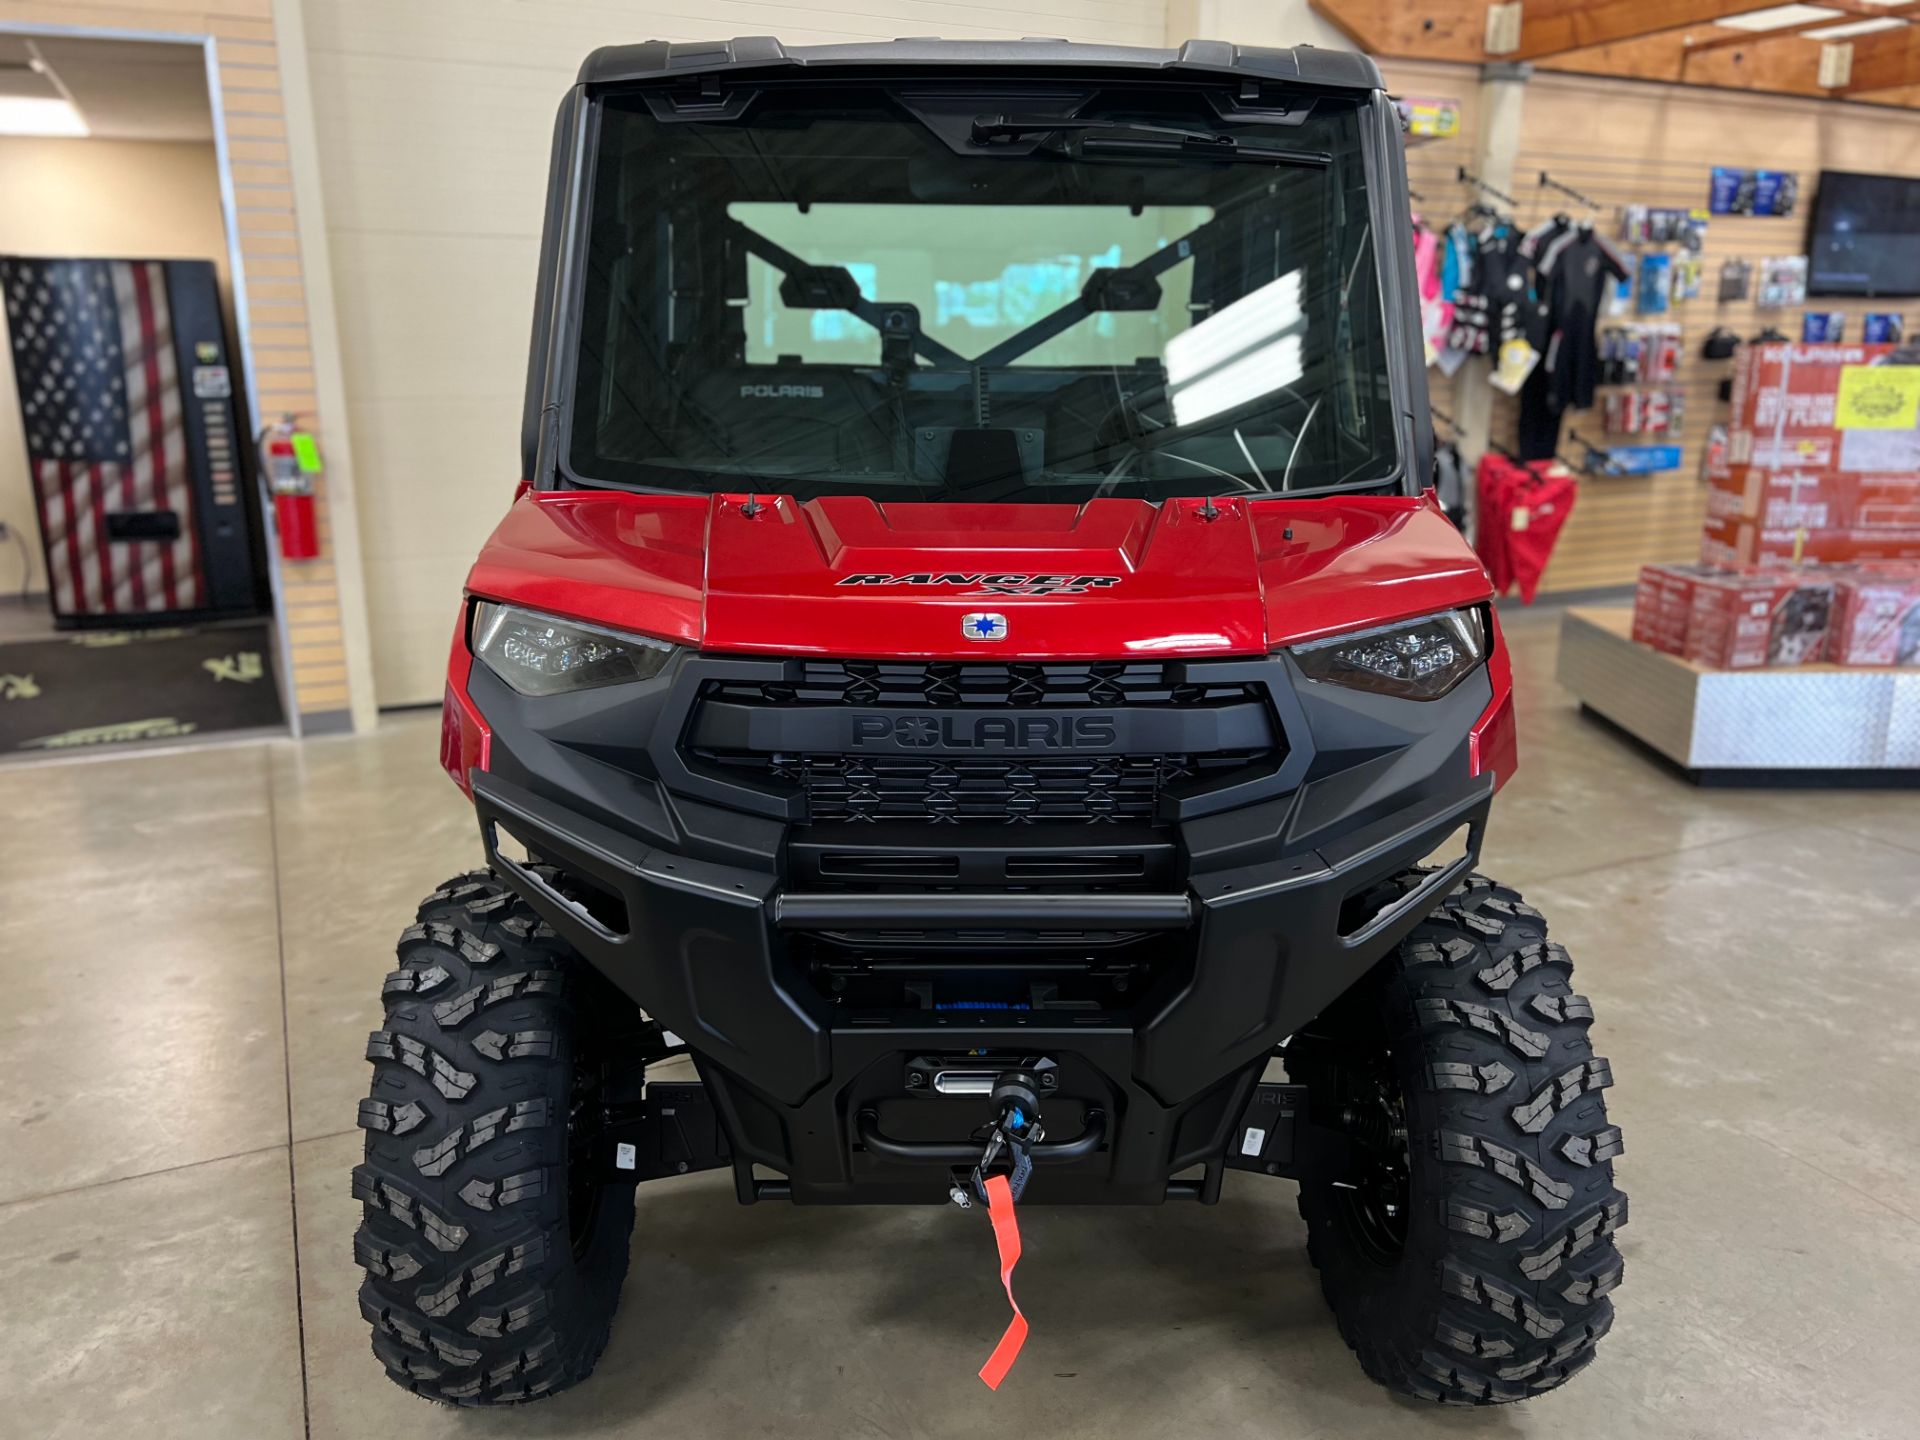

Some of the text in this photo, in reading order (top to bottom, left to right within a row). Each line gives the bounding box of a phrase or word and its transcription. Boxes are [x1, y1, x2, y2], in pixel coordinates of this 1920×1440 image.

[740, 384, 825, 398] POLARIS
[837, 573, 1123, 588] RANGER
[962, 585, 1089, 597] XP
[851, 715, 1117, 750] POLARIS
